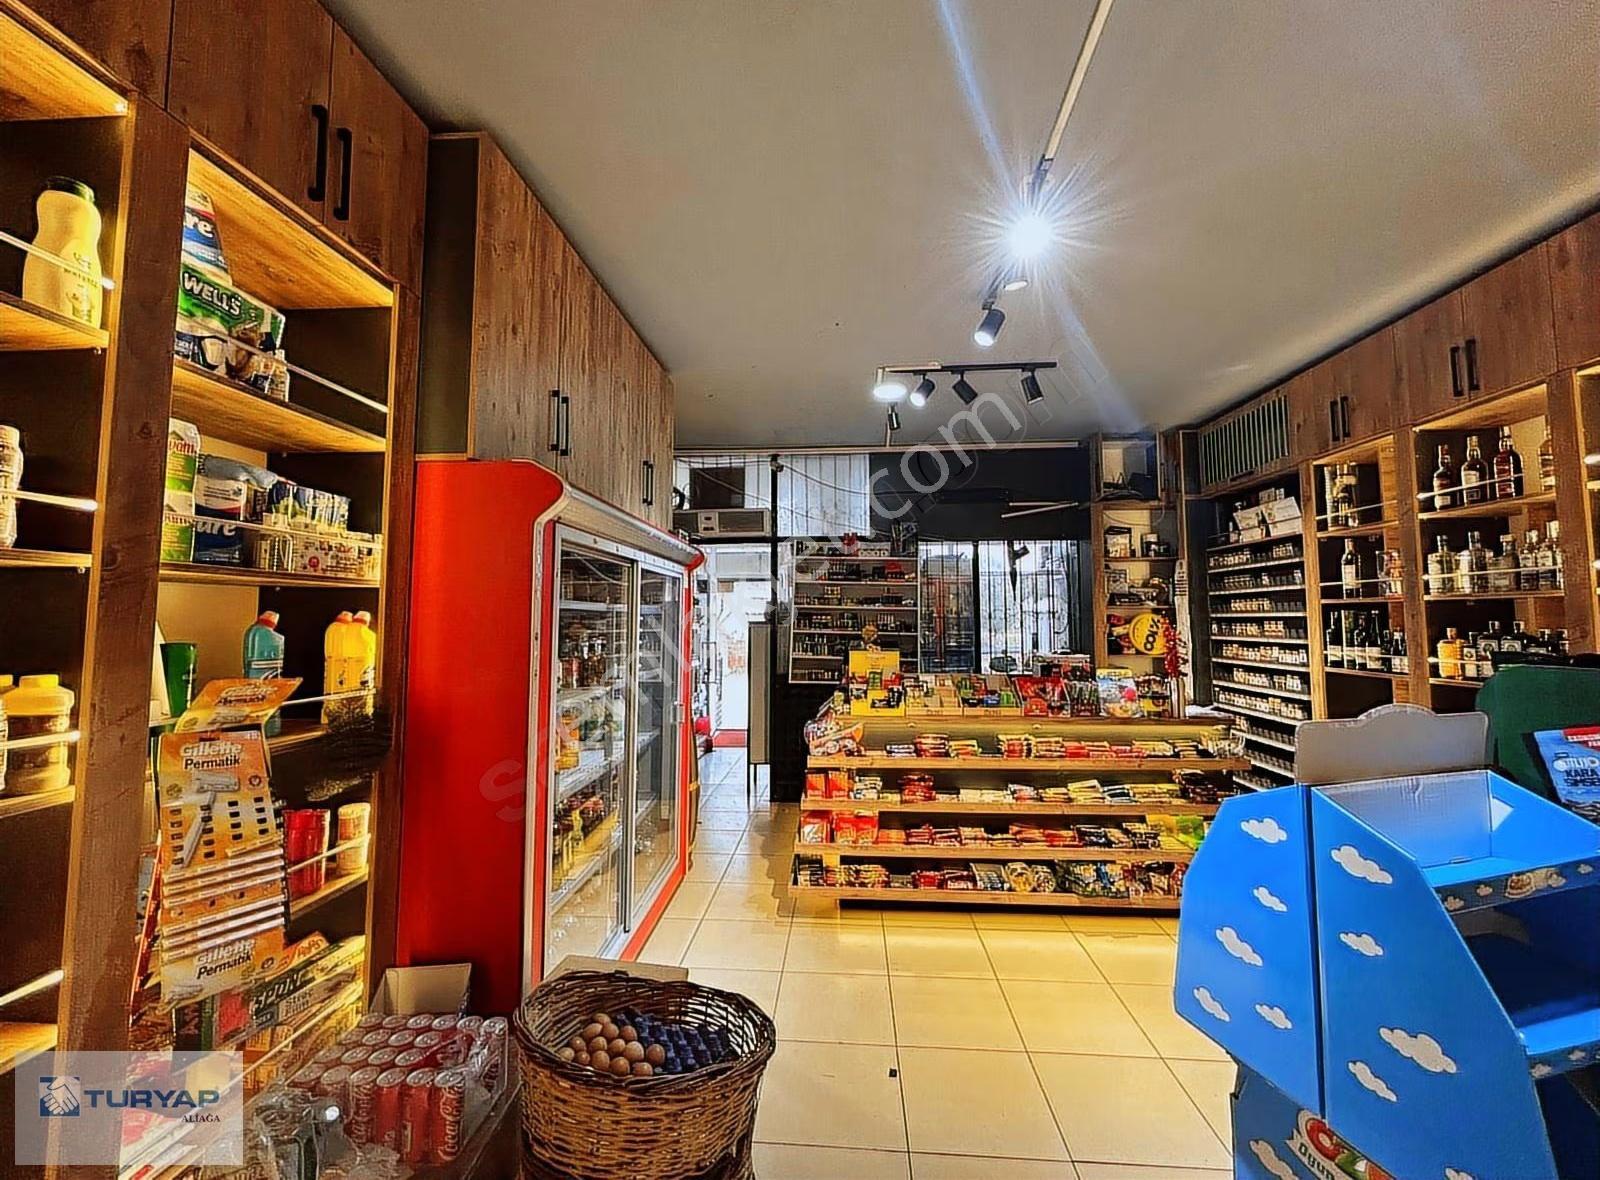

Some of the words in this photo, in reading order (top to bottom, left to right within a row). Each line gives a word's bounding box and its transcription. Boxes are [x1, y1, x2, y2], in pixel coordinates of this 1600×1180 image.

[180, 740, 243, 757] Gillette
[184, 755, 241, 770] Permatik
[196, 954, 254, 980] Permatik
